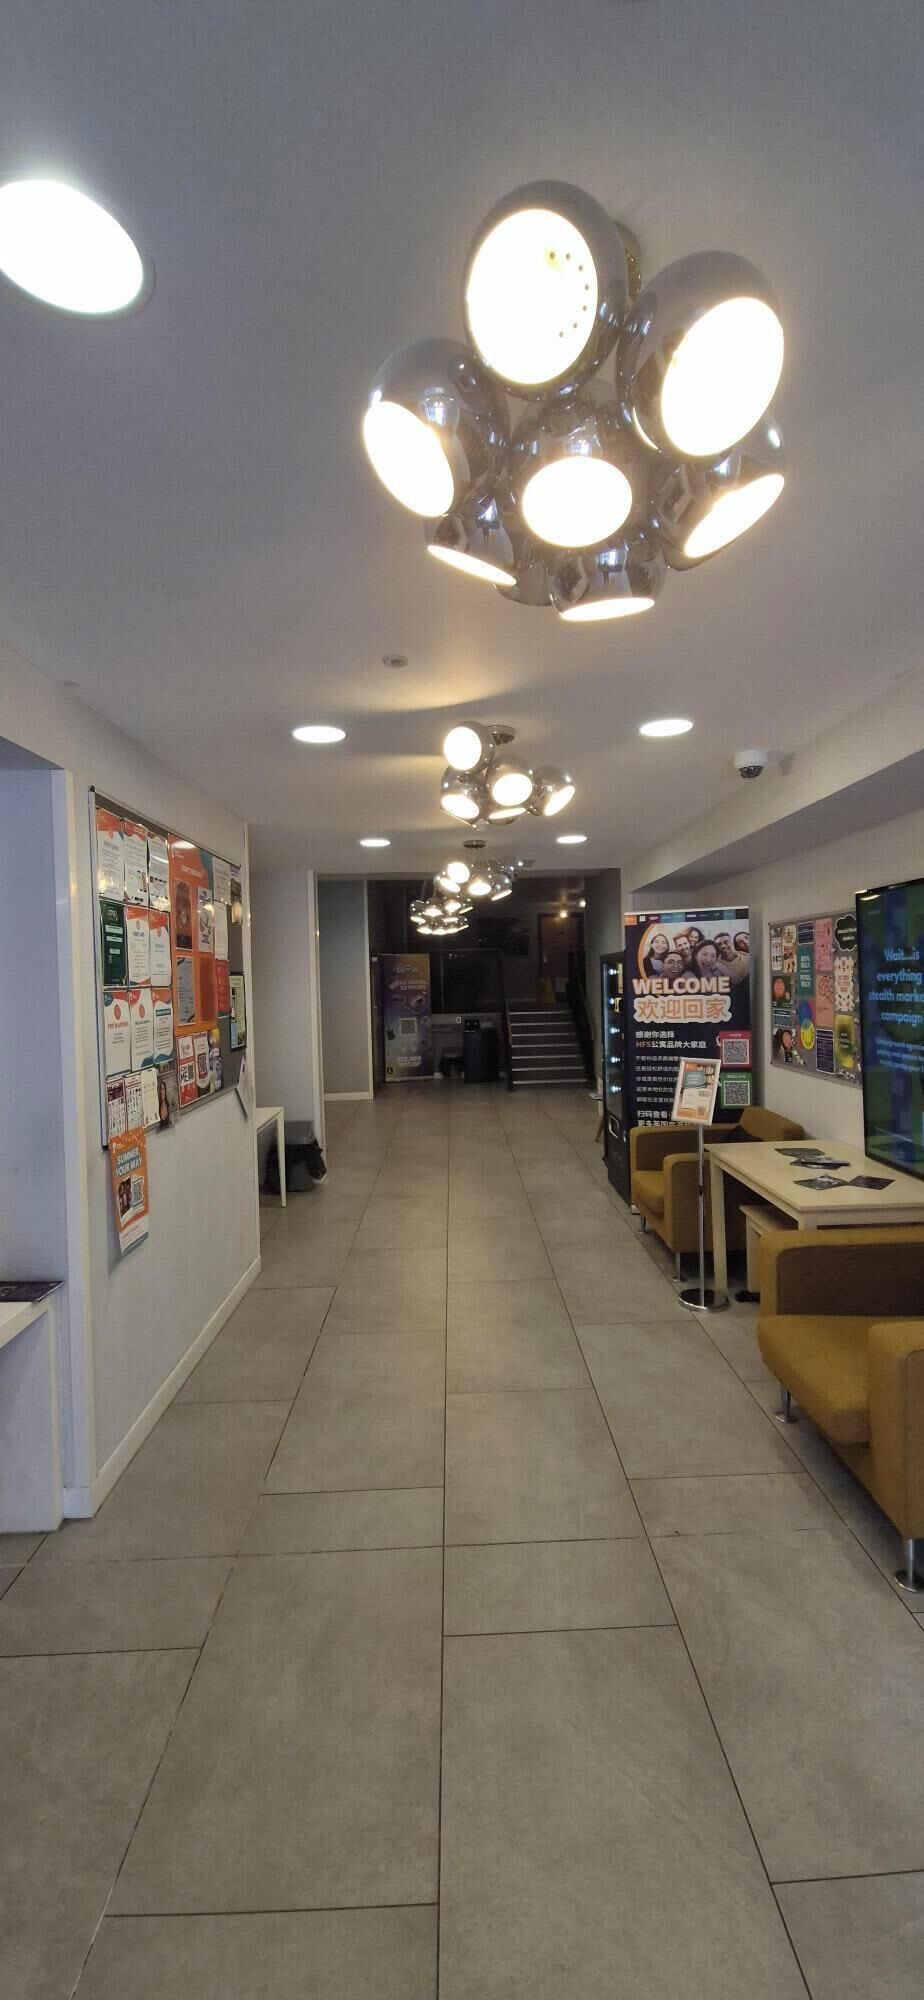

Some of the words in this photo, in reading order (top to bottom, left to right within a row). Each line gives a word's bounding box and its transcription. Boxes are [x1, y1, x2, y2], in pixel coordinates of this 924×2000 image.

[876, 968, 922, 985] everything
[632, 976, 731, 995] WELCOME
[869, 988, 895, 1001] stealth
[637, 998, 729, 1021] 欢迎回家
[635, 1030, 675, 1039] 感谢你选择
[635, 1040, 707, 1049] HFS公寓品牌大家庭
